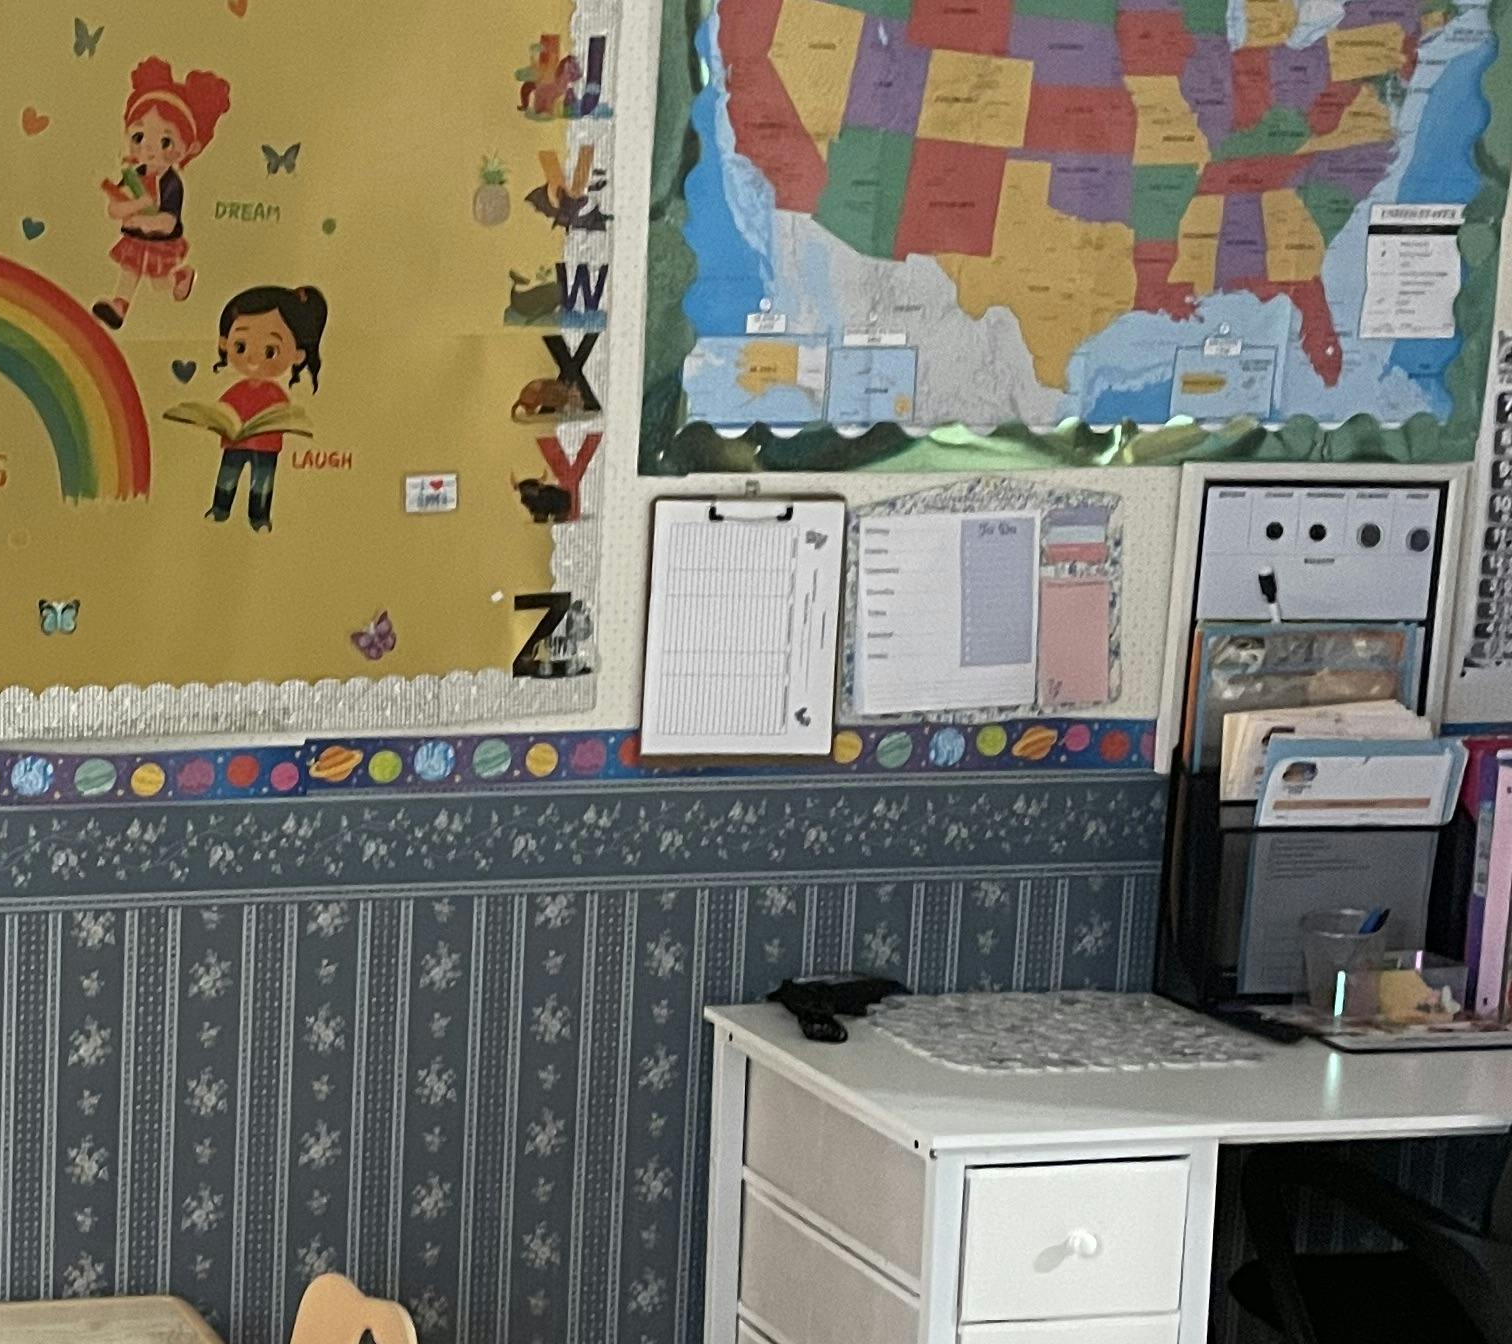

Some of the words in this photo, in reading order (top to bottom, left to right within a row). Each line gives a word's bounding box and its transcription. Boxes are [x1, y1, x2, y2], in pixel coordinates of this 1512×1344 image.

[214, 201, 281, 224] DREAM
[554, 262, 609, 316] W
[540, 332, 602, 412] X
[292, 449, 352, 470] LAUGH
[535, 432, 604, 522] Y
[512, 591, 592, 678] Z
